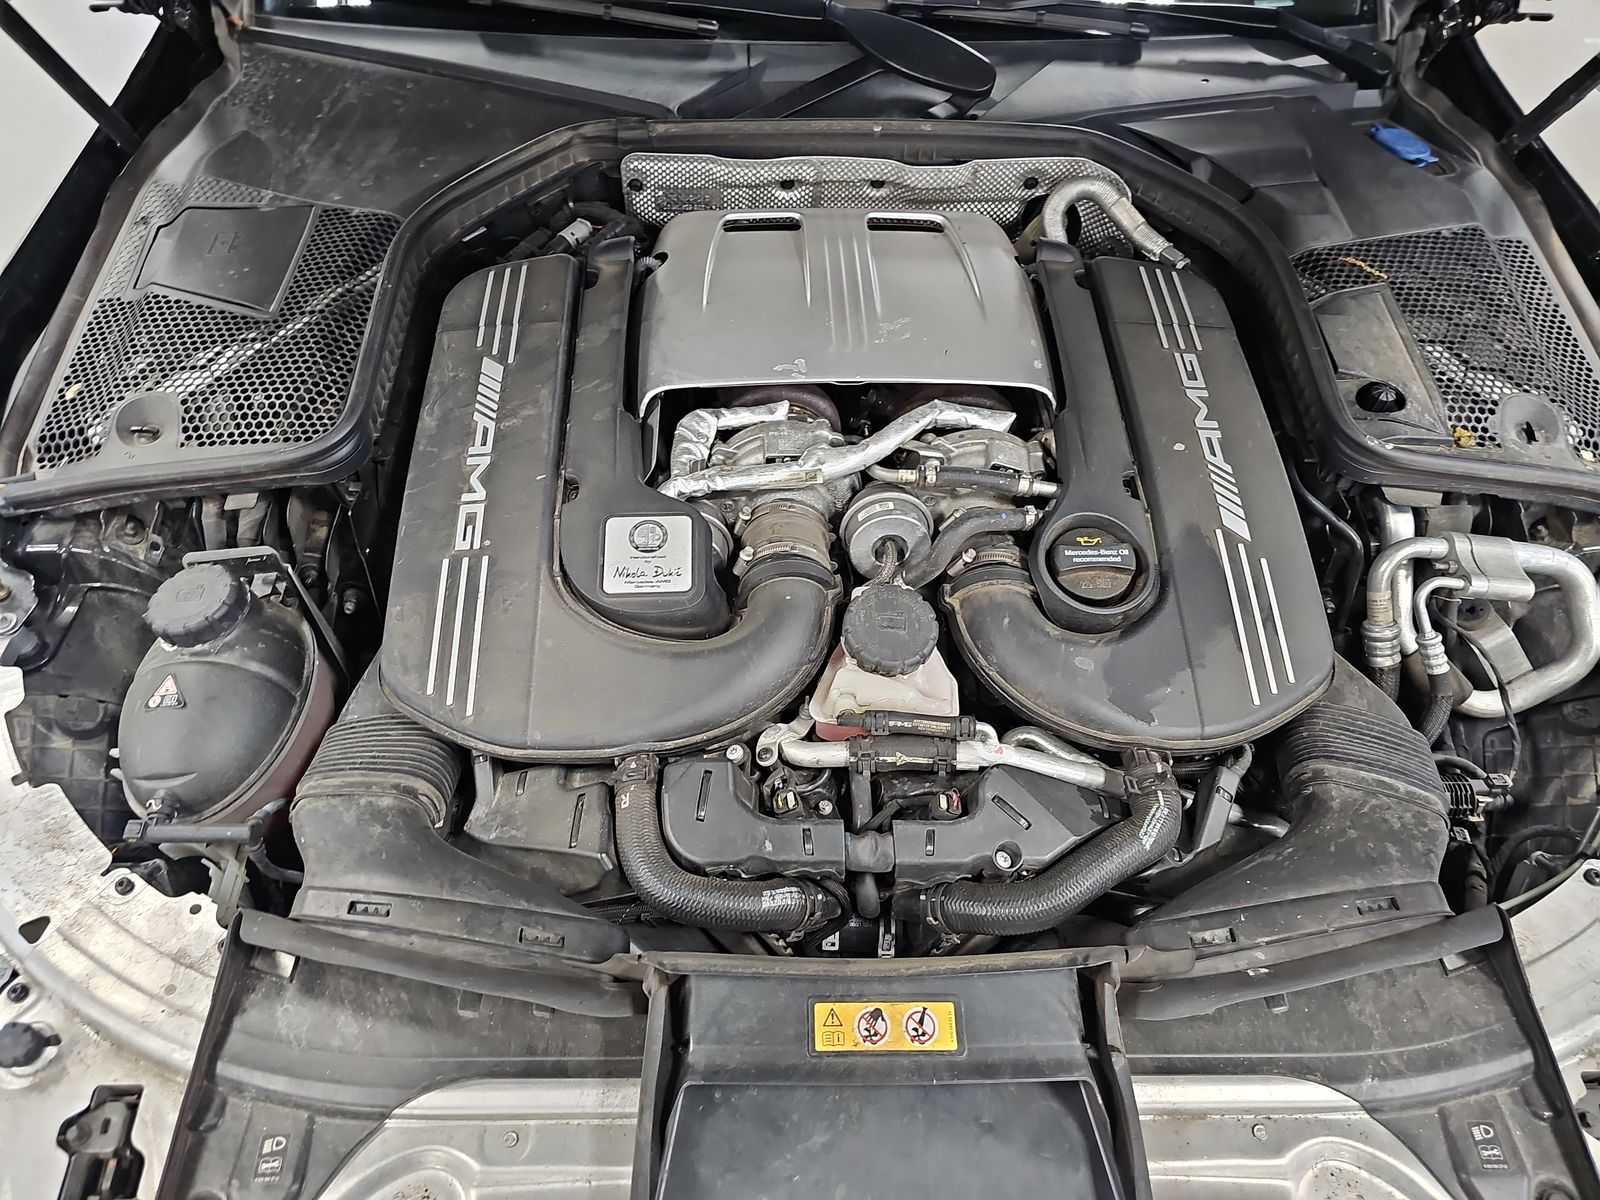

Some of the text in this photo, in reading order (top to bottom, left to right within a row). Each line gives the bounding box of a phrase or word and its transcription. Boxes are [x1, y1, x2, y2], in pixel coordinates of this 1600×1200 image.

[1173, 352, 1233, 475] AMG
[454, 411, 497, 551] AMG
[1064, 548, 1118, 556] Mercedes-Benz
[1072, 555, 1122, 563] recommended
